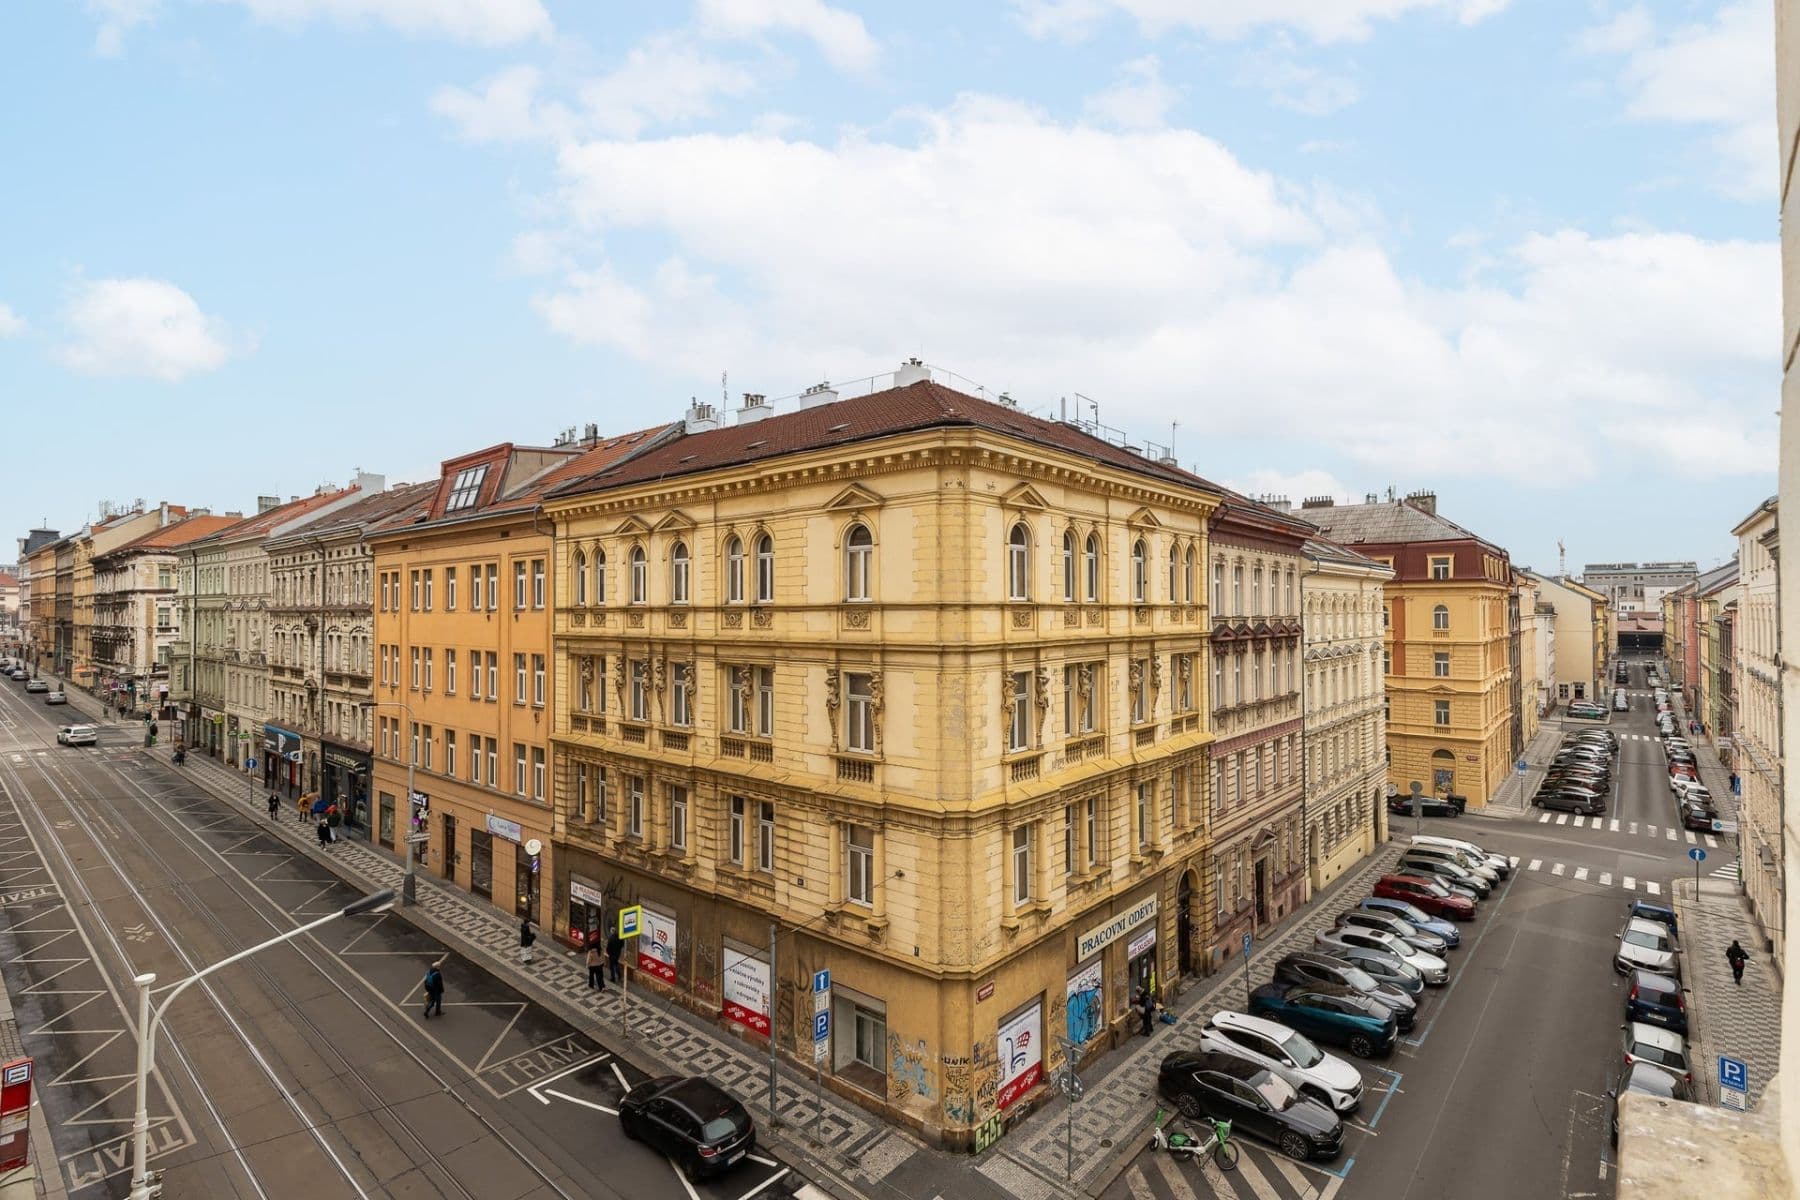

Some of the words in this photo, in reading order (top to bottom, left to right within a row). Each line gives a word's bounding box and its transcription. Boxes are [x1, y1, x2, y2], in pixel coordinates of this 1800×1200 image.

[0, 888, 58, 904] TRA
[1081, 913, 1126, 955] PRACOVNÍ
[1128, 901, 1155, 926] ODĚVY
[817, 1016, 827, 1033] P
[490, 1039, 590, 1086] TRAM
[1724, 1060, 1741, 1079] P
